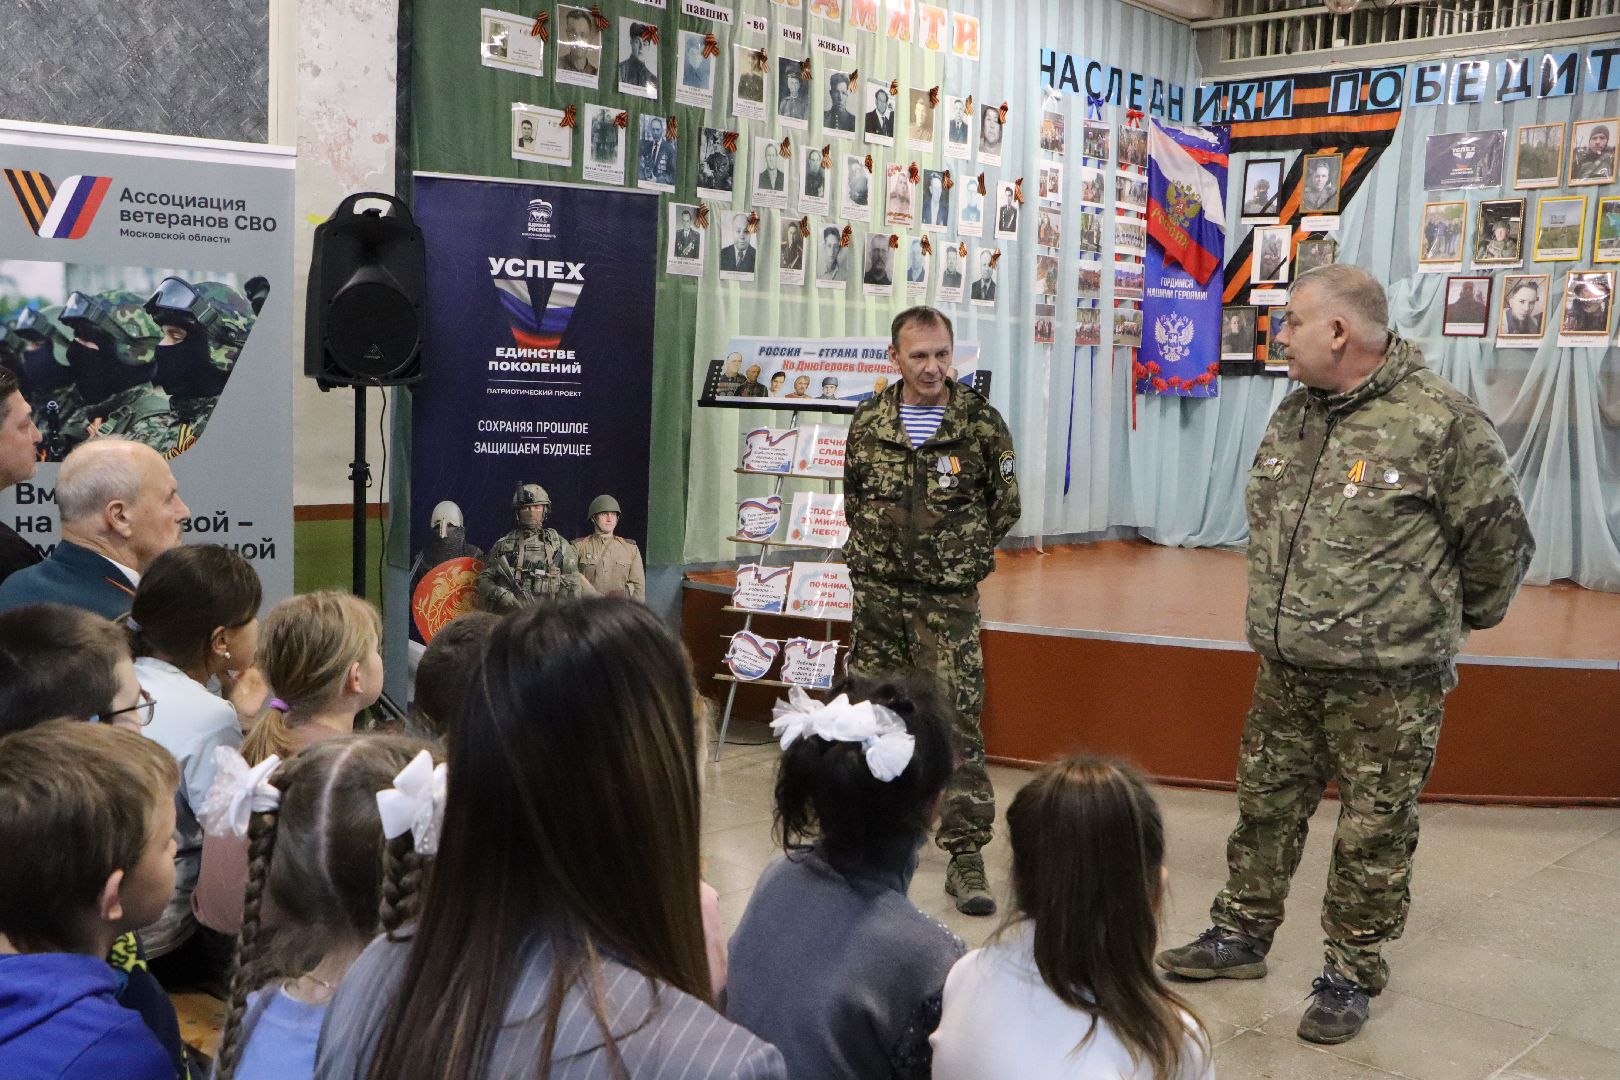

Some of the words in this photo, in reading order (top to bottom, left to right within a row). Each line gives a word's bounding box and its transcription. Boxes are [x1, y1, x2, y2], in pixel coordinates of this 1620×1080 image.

[686, 3, 730, 22] павших
[753, 20, 765, 31] во
[783, 28, 802, 41] имя
[817, 38, 851, 55] живых
[770, 0, 979, 56] АМЯТИ
[1040, 48, 1292, 122] НАСЛЕДНИКИ
[119, 187, 247, 212] Ассоциация
[119, 209, 229, 231] ветеранов
[234, 215, 277, 233] СВО
[120, 228, 186, 243] Московской
[188, 233, 231, 244] области
[488, 257, 586, 281] УСПЕХ
[1160, 276, 1194, 289] ГОРДИМСЯ
[1174, 289, 1208, 301] ГЕРОЯМИ!
[496, 347, 576, 360] ЕДИНСТВЕ
[759, 346, 802, 357] РОССИЯ
[818, 347, 858, 359] СТРАНА
[861, 348, 889, 360] ПОБЕ
[488, 361, 582, 374] ПОКОЛЕНИЙ
[796, 360, 820, 372] Дню
[820, 360, 855, 372] Героев
[486, 387, 553, 397] ПАТРИОТИЧЕСКИЙ
[554, 389, 582, 397] ПРОЕКТ
[478, 420, 533, 433] СОХРАНЯЯ
[536, 421, 589, 434] ПРОШЛОЕ
[474, 441, 540, 456] ЗАЩИЩАЕМ
[543, 443, 592, 457] БУДУЩЕЕ
[819, 448, 845, 456] СЛАВ
[15, 515, 53, 533] на
[814, 517, 848, 527] МИРНО
[812, 528, 840, 537] НЕБО!
